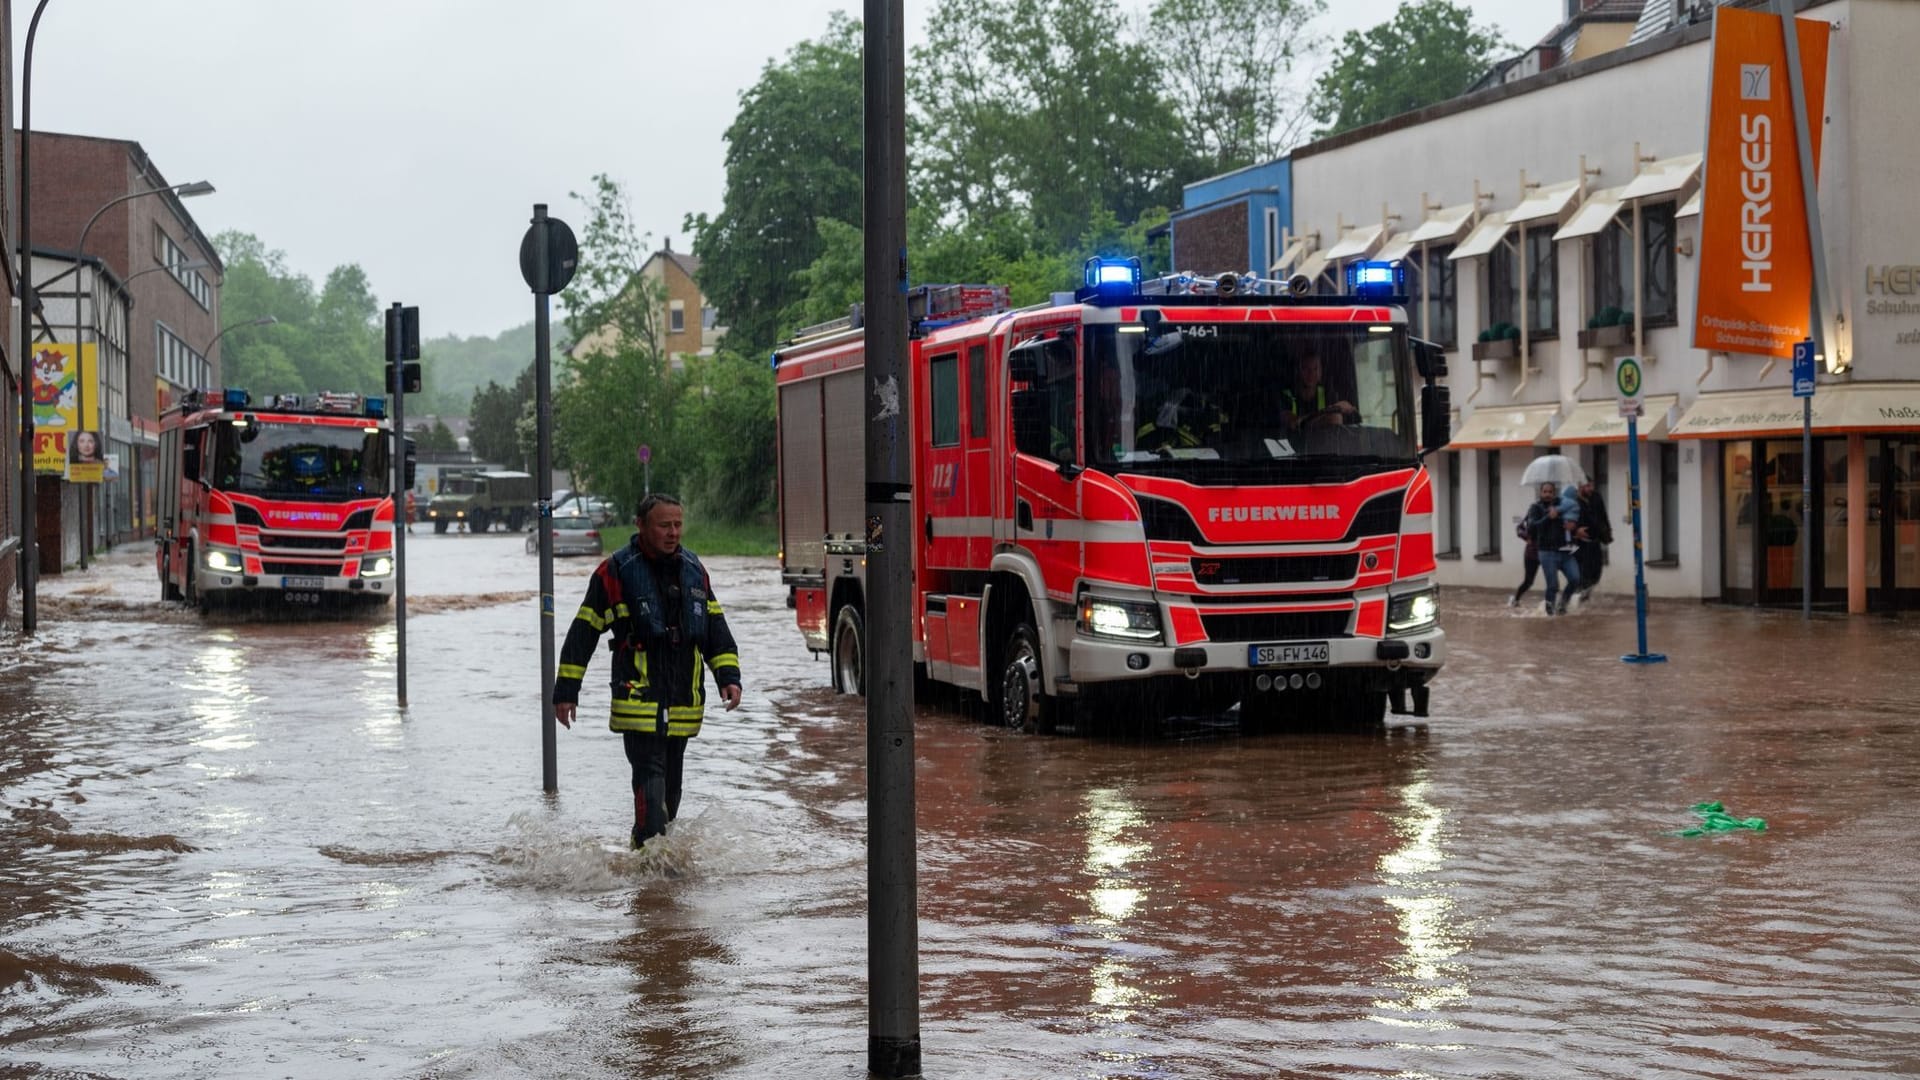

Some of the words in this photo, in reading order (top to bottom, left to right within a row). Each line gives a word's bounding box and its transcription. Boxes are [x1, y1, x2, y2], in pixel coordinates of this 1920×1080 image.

[1741, 114, 1772, 292] HERGES
[1796, 345, 1807, 369] P
[932, 463, 953, 489] 112
[268, 510, 339, 522] FEUERWEHR
[1208, 504, 1341, 522] FEUERWEHR
[1258, 648, 1275, 662] SB
[1283, 647, 1301, 661] FW
[1303, 646, 1327, 661] 146
